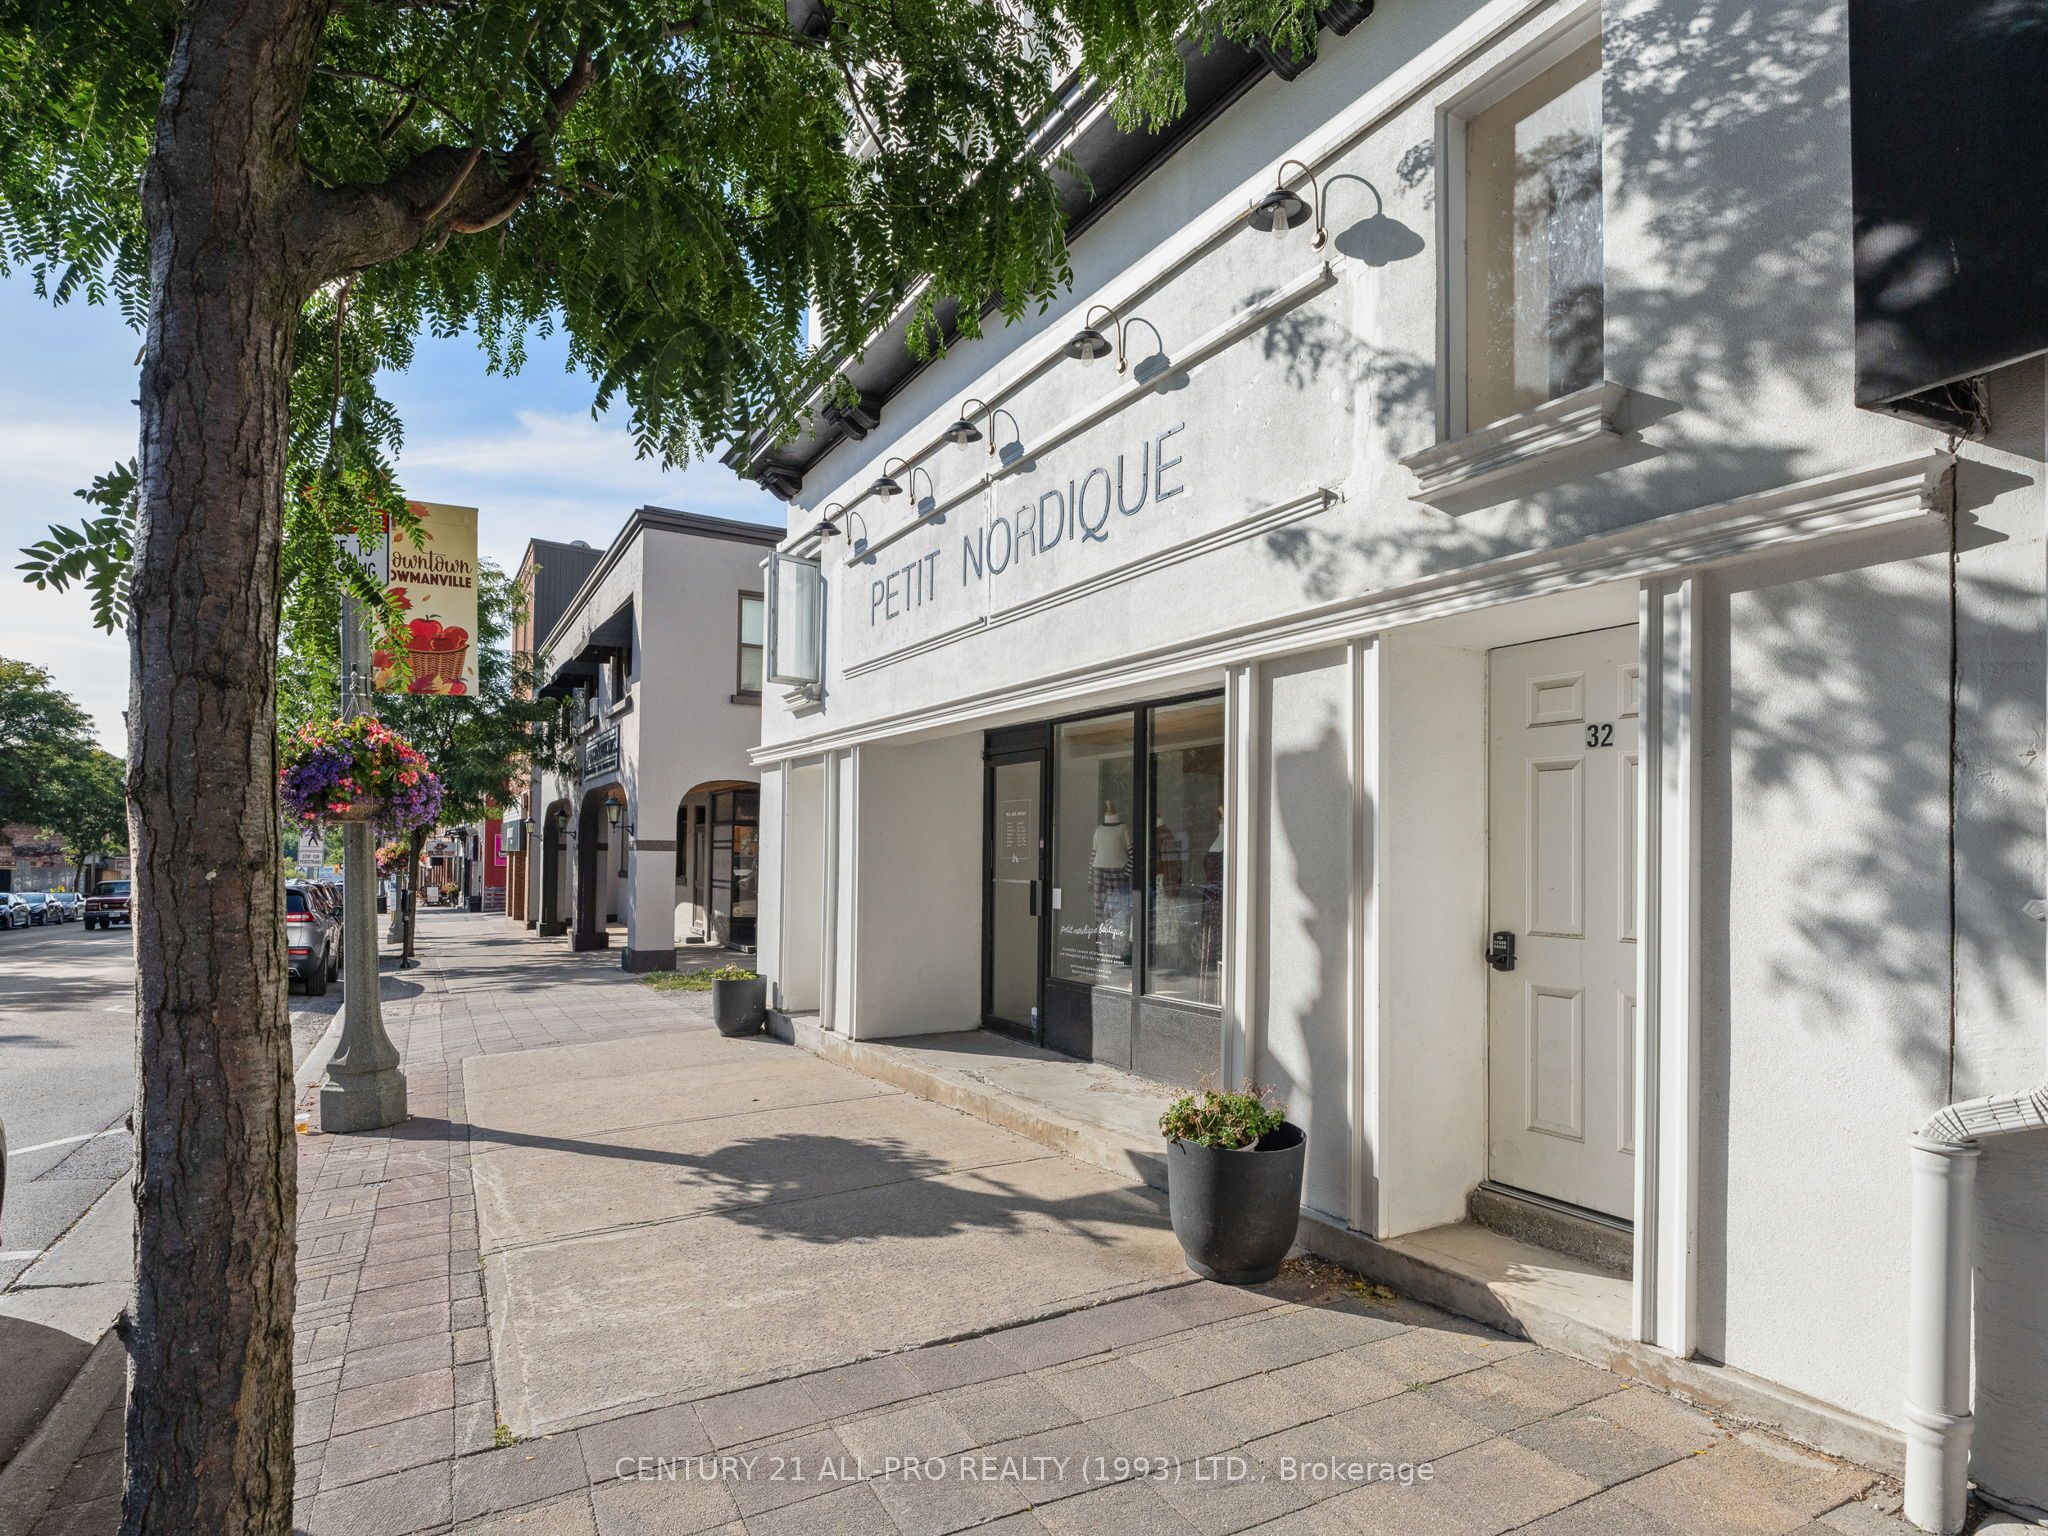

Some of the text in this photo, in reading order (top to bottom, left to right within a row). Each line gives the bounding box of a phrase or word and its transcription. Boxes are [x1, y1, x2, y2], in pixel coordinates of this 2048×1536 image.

[871, 421, 1185, 627] PETIT NORDIQUE
[392, 550, 473, 574] owntown
[390, 569, 472, 589] OWMANVILLE
[1586, 723, 1613, 748] 32
